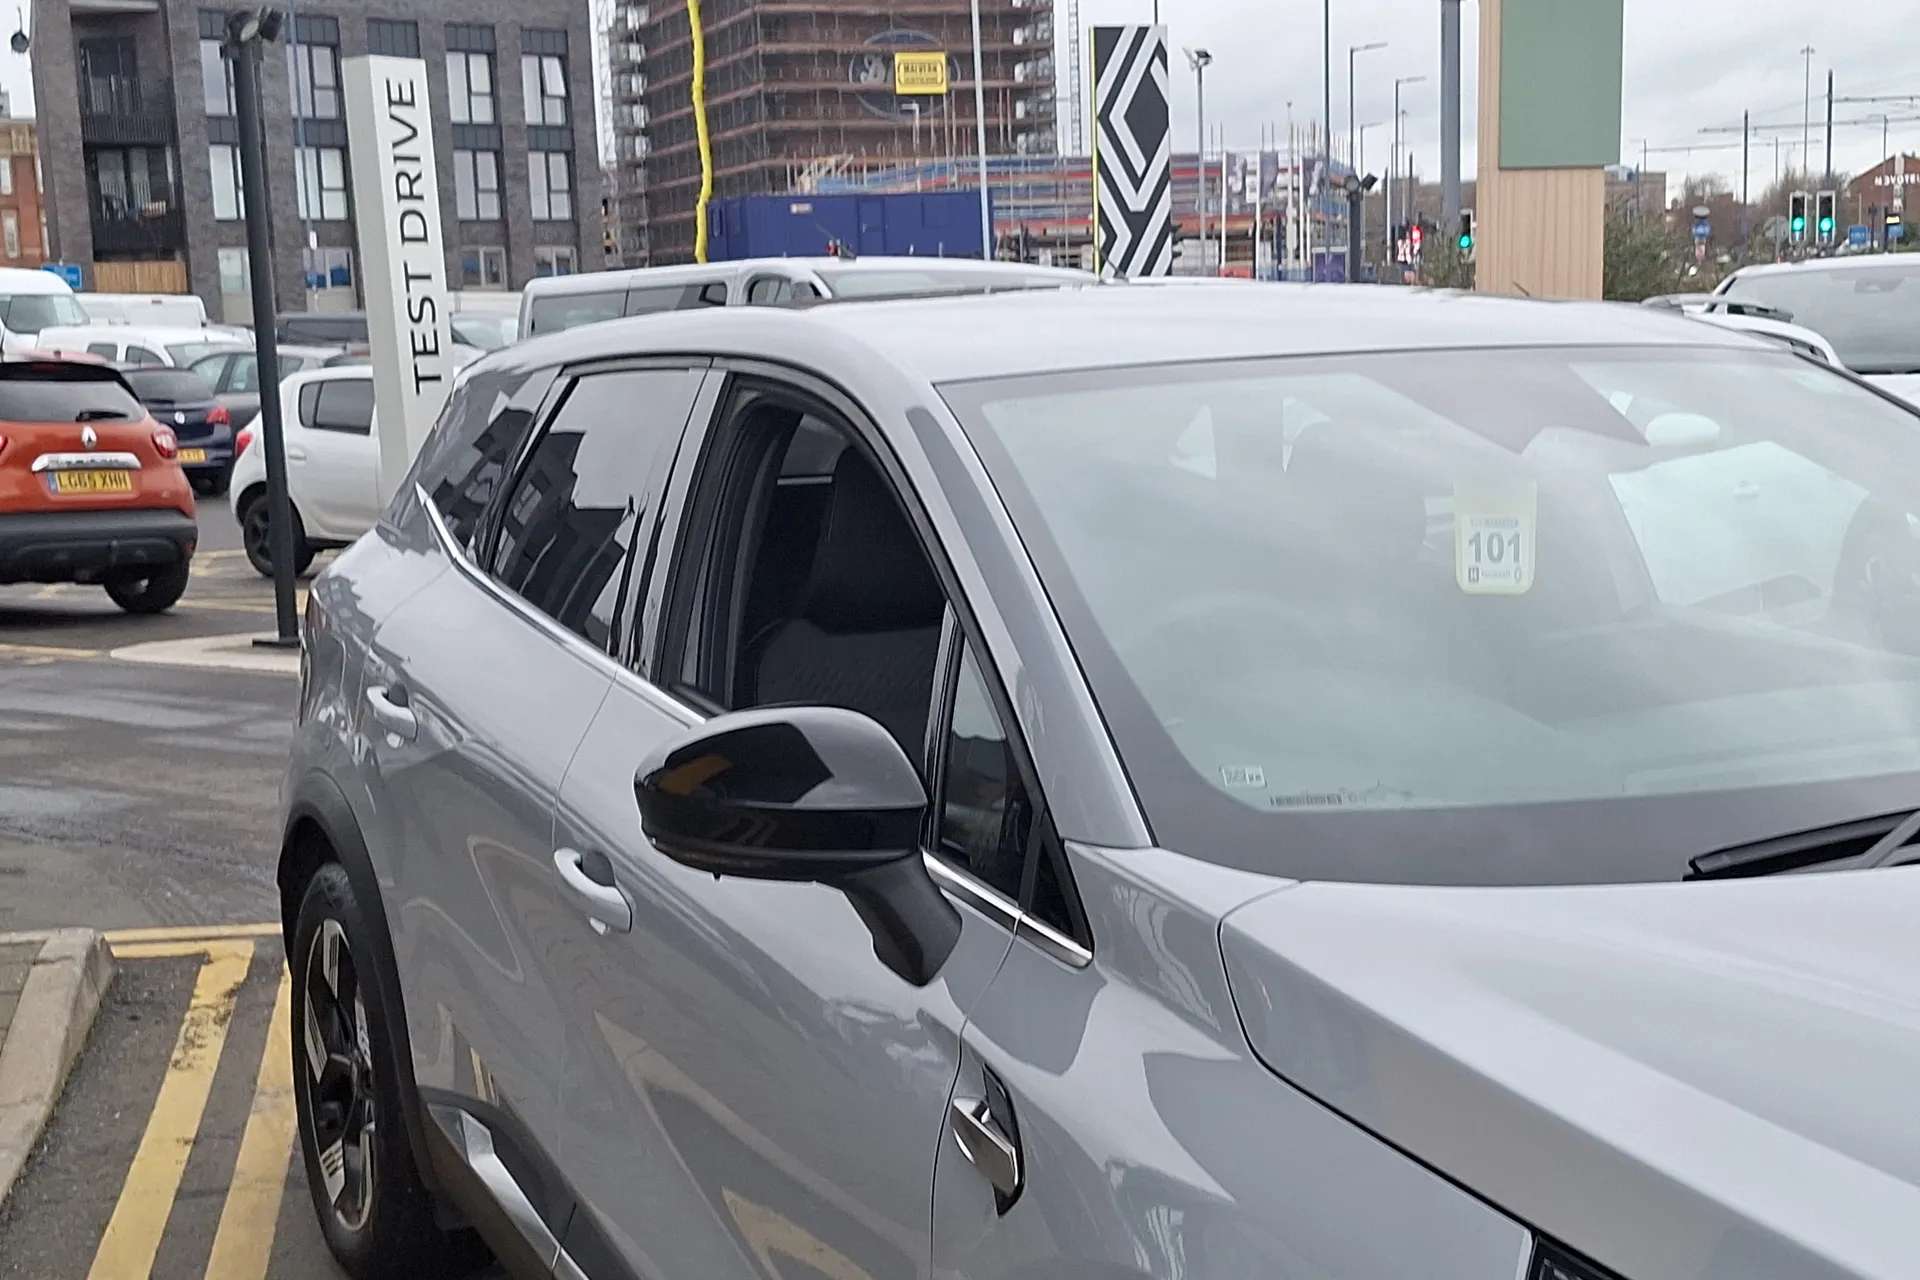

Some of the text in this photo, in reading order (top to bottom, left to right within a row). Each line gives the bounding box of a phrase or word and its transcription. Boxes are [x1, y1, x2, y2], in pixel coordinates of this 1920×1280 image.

[386, 77, 442, 395] TEST DRIVE
[1468, 532, 1521, 563] 101
